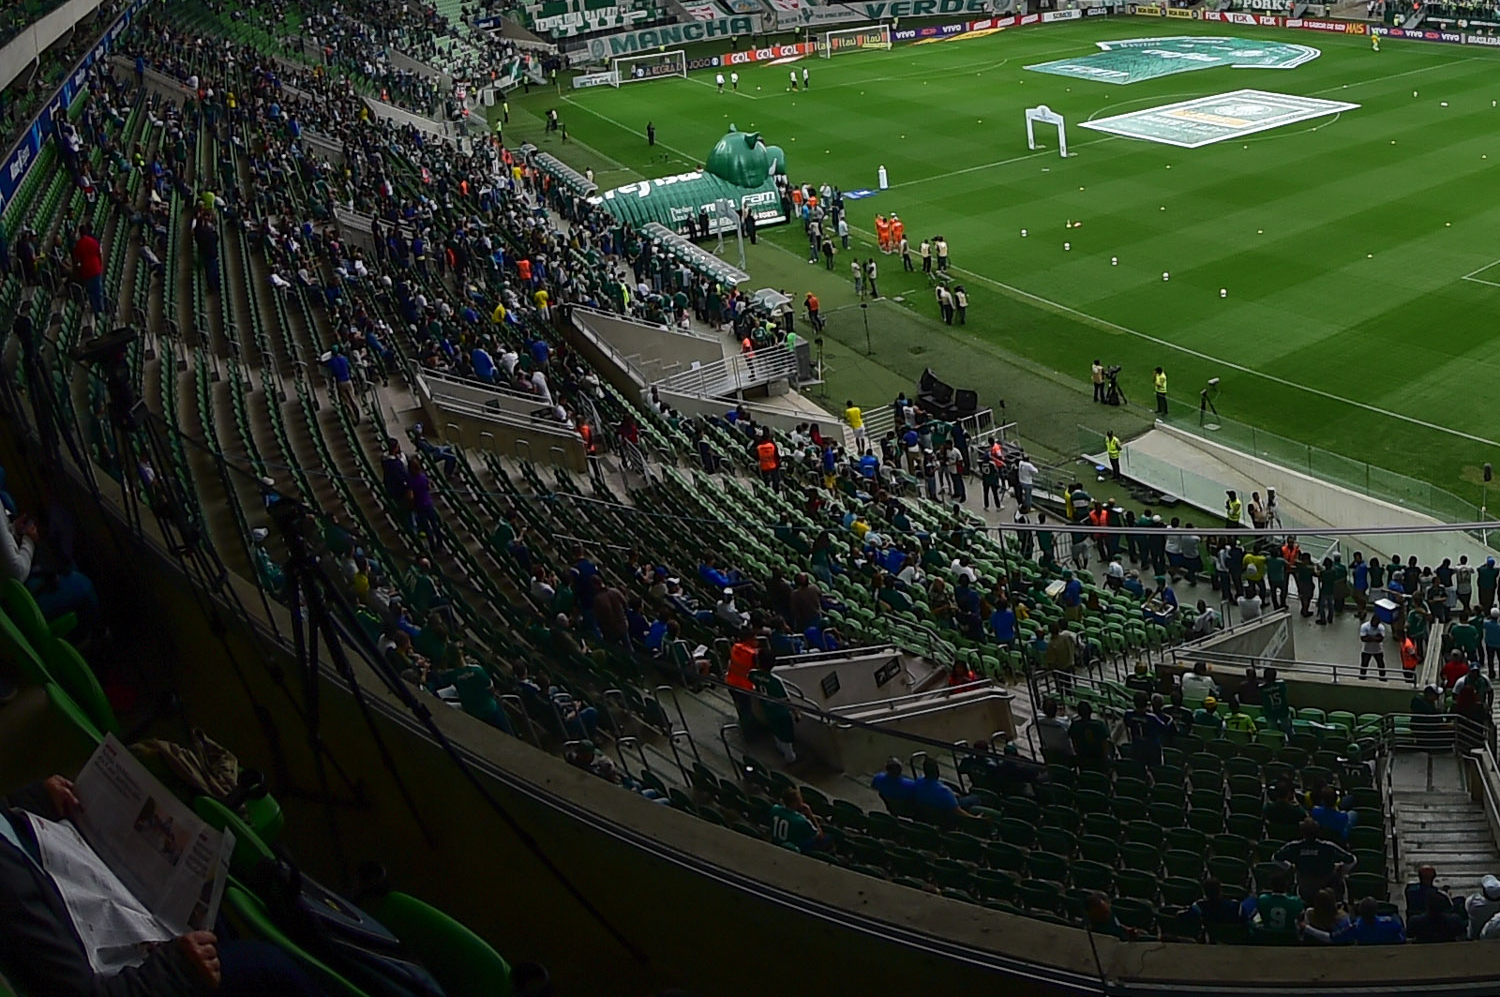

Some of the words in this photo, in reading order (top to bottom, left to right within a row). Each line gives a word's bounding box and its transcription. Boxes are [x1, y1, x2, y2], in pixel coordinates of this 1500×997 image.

[609, 16, 753, 56] MANCHA
[756, 48, 775, 60] GOL
[780, 45, 799, 57] GOL
[689, 58, 711, 69] JOGO
[731, 52, 750, 64] GOL
[772, 815, 790, 841] 10
[1270, 906, 1287, 927] 9
